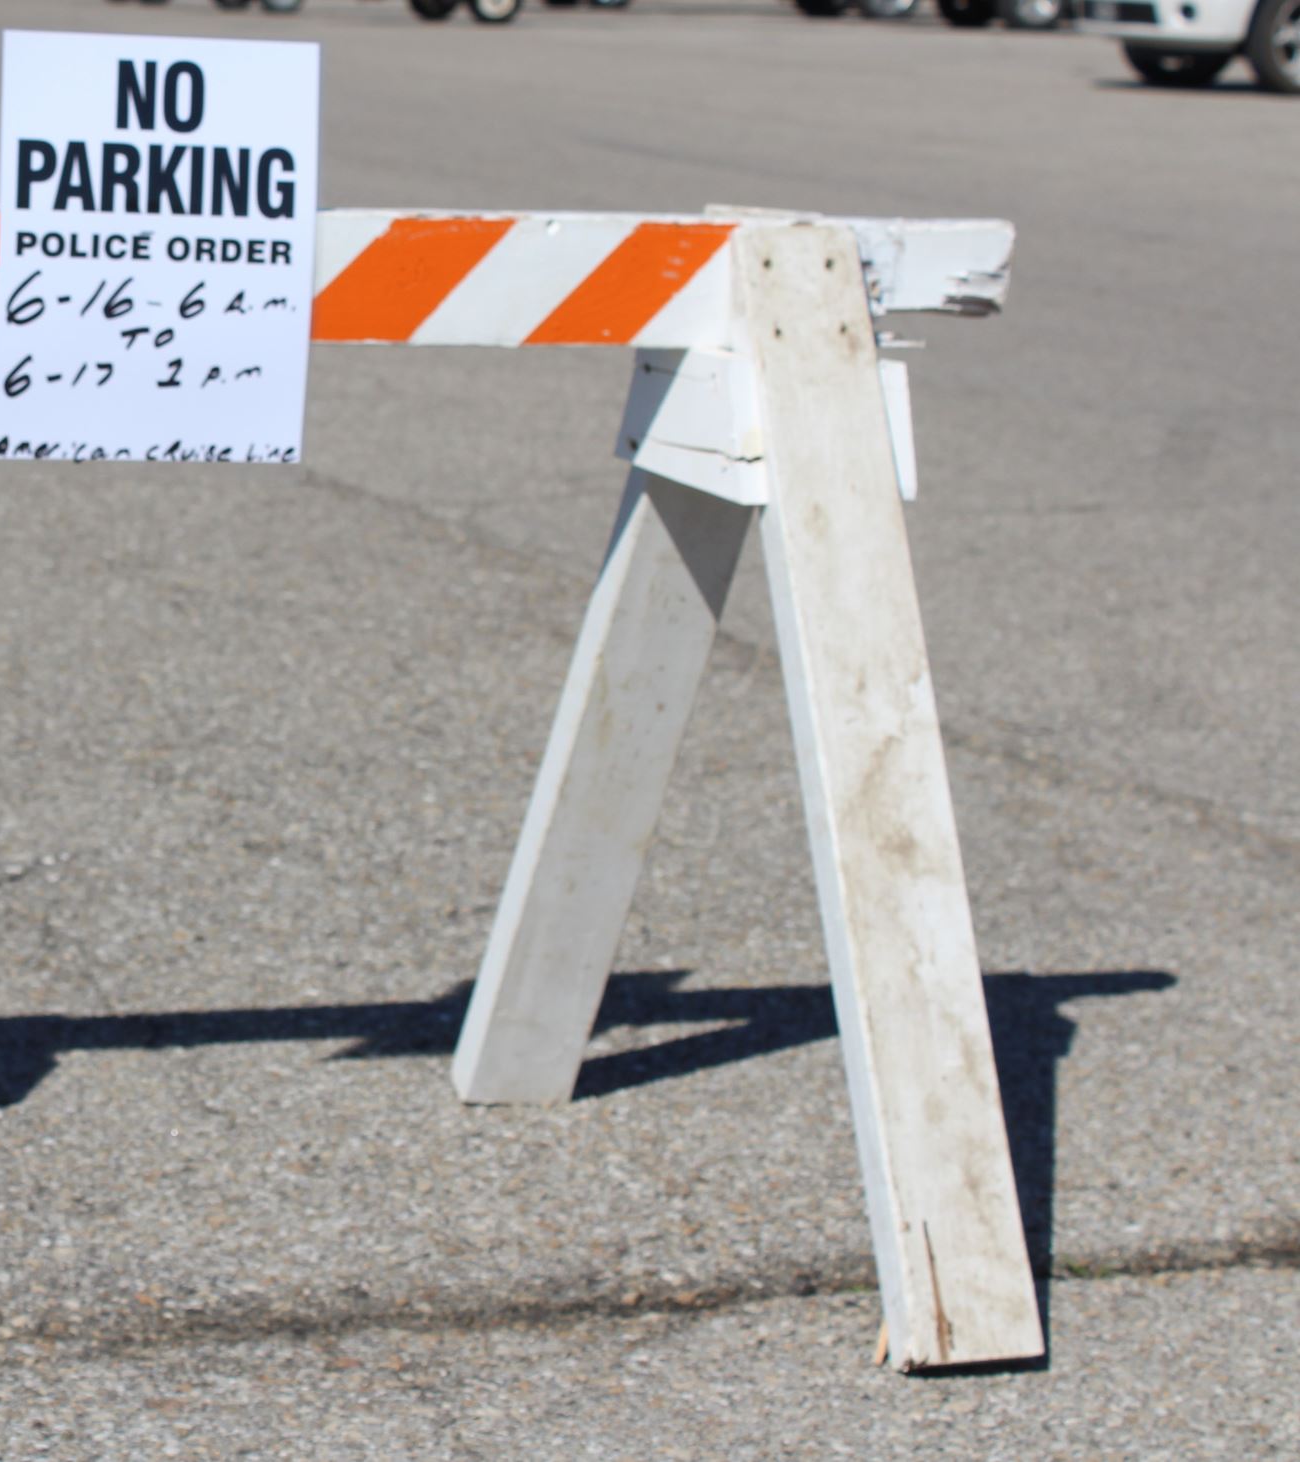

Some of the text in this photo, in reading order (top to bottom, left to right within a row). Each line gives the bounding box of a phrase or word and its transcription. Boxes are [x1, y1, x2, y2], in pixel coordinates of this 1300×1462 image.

[116, 59, 205, 133] NO
[16, 139, 296, 219] PARKING
[16, 232, 292, 264] POLICE ORDER
[121, 327, 174, 350] TO
